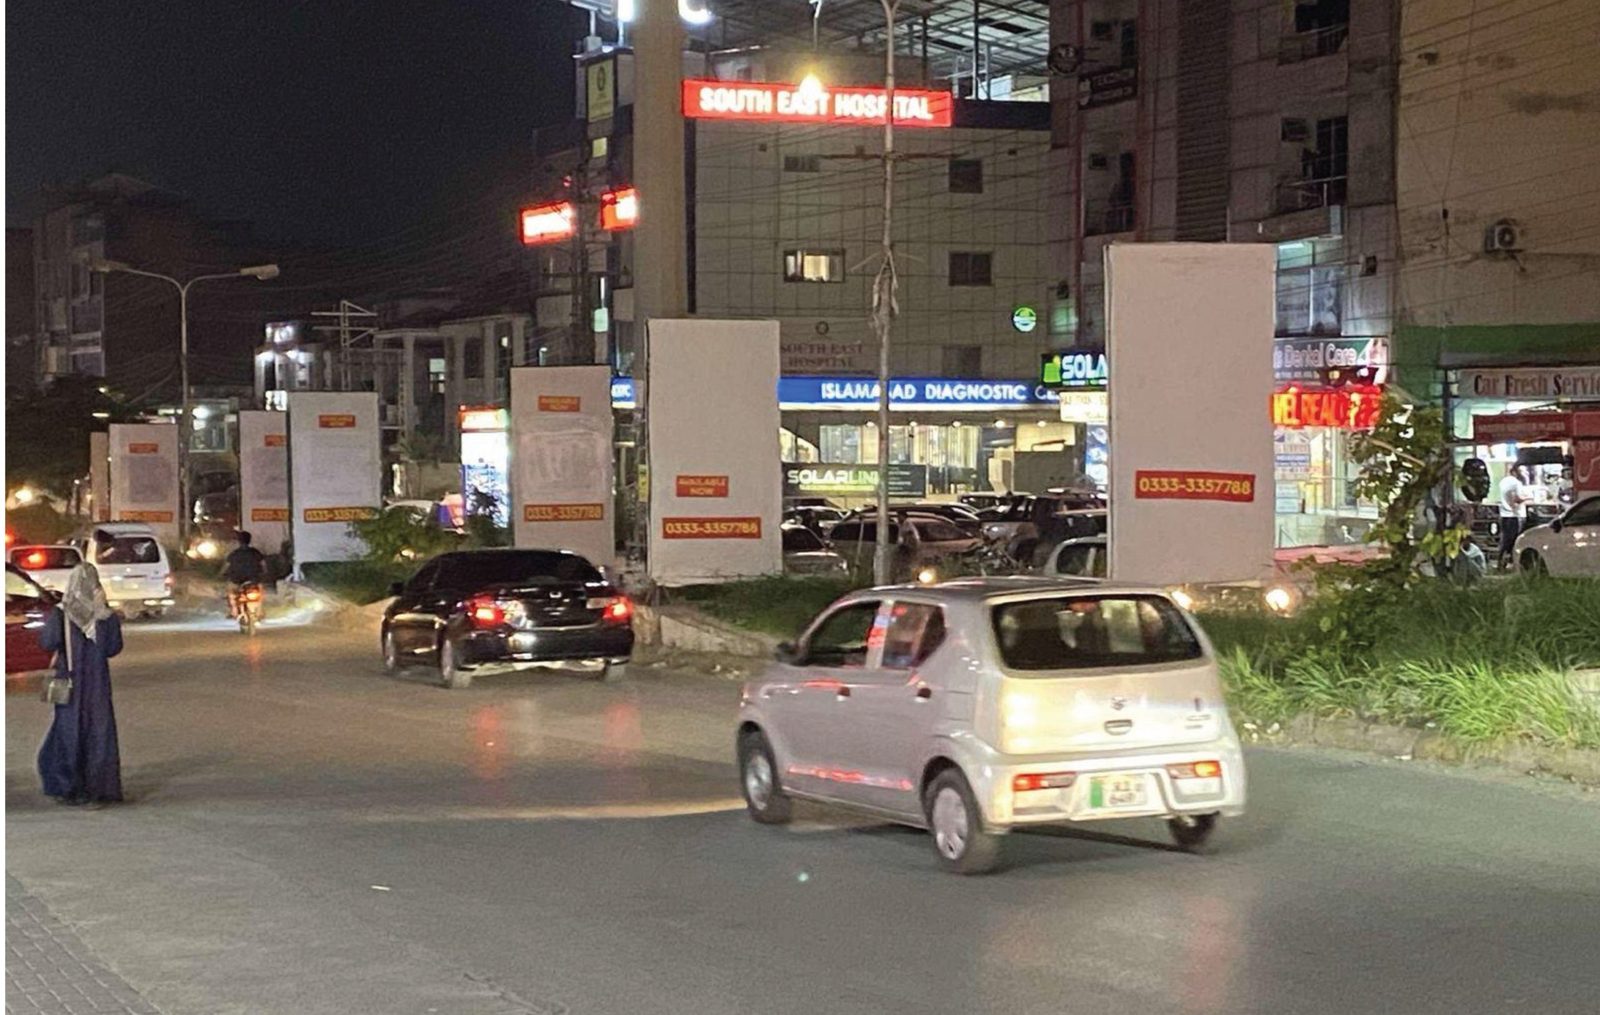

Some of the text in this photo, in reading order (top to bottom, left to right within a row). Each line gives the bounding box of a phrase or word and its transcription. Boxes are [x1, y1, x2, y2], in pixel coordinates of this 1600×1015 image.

[699, 87, 773, 113] SOUTH
[777, 91, 830, 116] EAST
[1325, 342, 1358, 367] Care
[821, 382, 917, 400] ISLAMAAD
[925, 383, 1027, 401] DIAGNOSTIC
[1474, 374, 1499, 396] Car
[1505, 374, 1549, 396] Fresh
[787, 469, 880, 485] SOLARLIN
[1139, 477, 1252, 495] 0333-3357788
